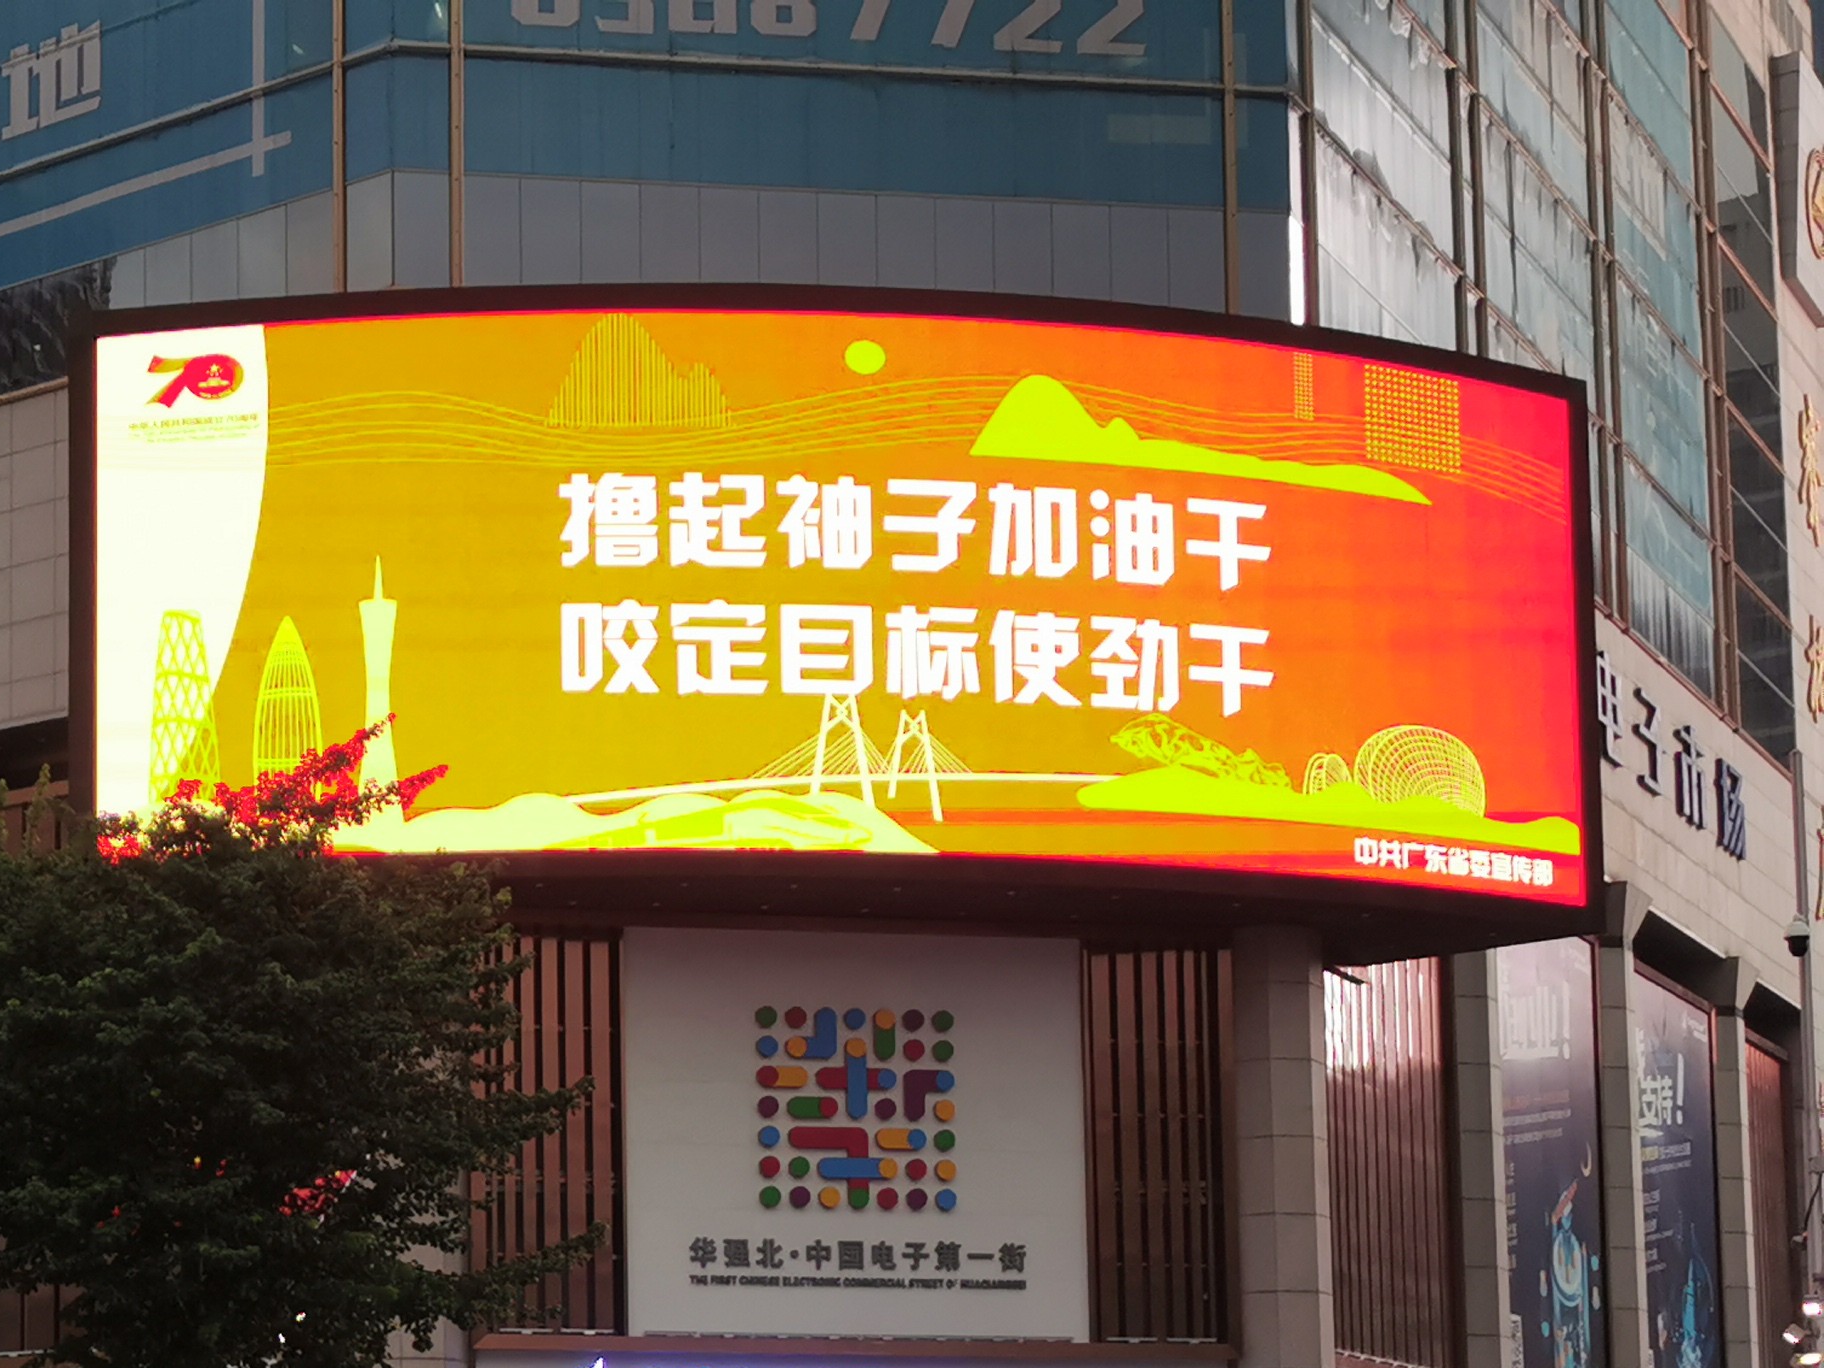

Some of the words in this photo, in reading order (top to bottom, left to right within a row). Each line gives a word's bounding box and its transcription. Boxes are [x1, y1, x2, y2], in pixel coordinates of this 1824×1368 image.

[558, 472, 1273, 591] 撸起袖子加油干
[560, 599, 1276, 717] 咬定目标使劲干
[1354, 836, 1553, 886] 中共广东省委宣传部
[689, 1237, 1026, 1272] 华强北·中国电子第一街
[690, 1275, 708, 1285] THE
[710, 1275, 737, 1286] FIRST
[783, 1276, 841, 1287] ELECTRONIC
[843, 1277, 906, 1288] COMMERCIAL
[909, 1278, 944, 1289] STREET
